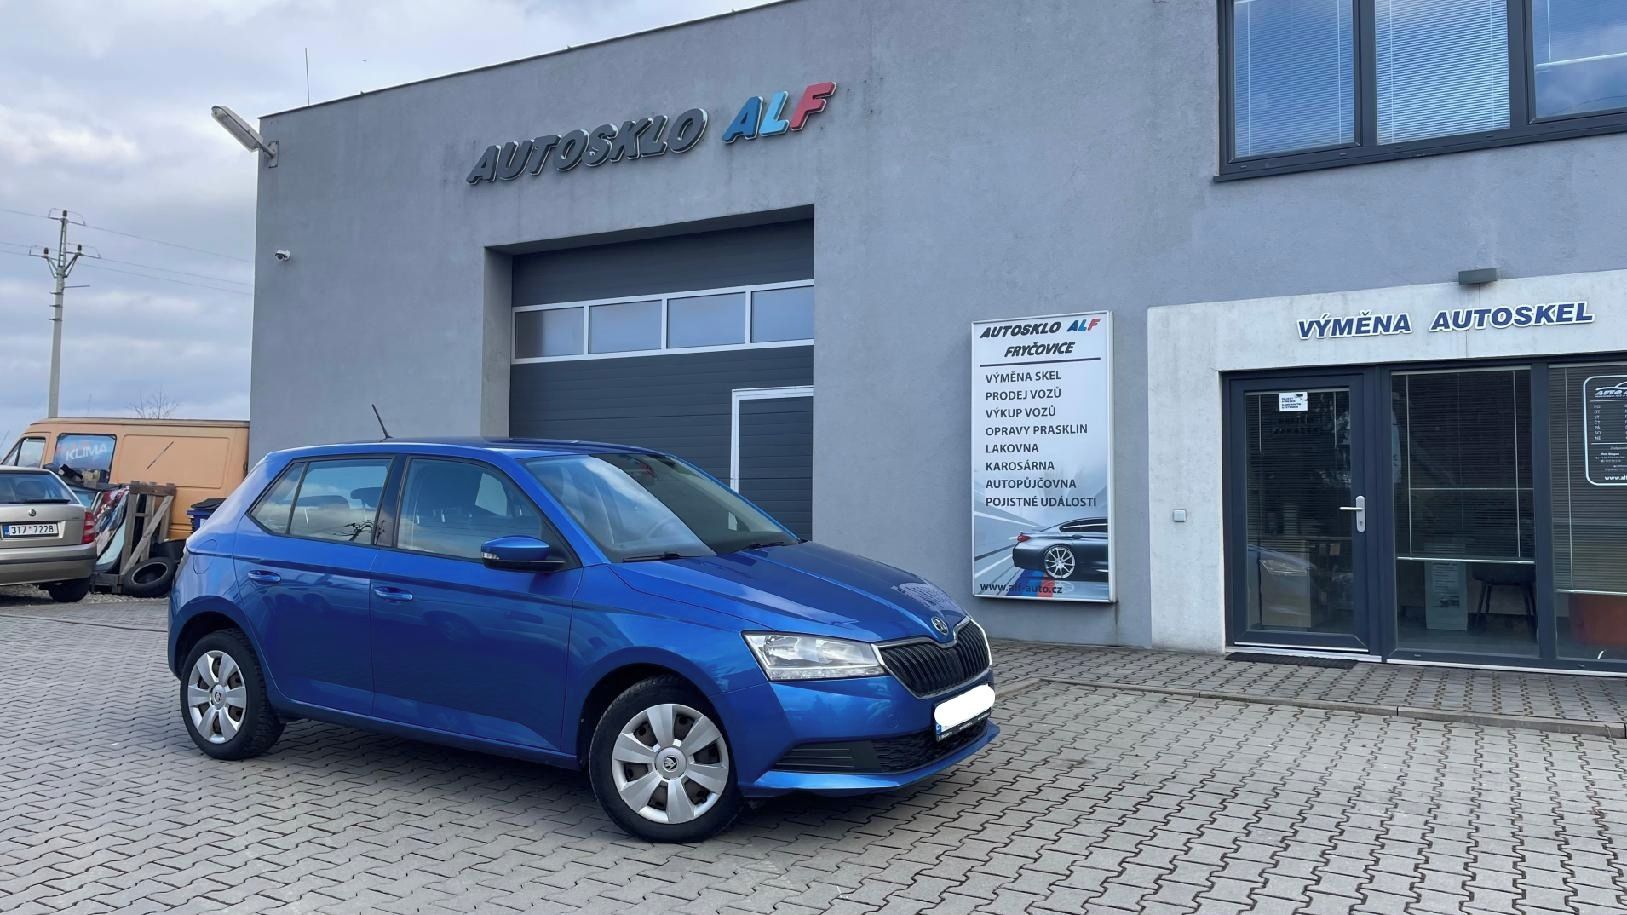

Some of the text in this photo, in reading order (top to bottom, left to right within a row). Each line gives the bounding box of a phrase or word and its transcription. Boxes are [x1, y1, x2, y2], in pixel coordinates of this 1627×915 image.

[466, 81, 837, 185] AUTOSKLO ALF
[1298, 302, 1594, 339] VÝMĚNA AUTOSKEL
[980, 319, 1101, 338] AUTOSKLO ALF
[1004, 342, 1075, 357] FRYČOVICE
[985, 371, 1062, 384] VÝMĚNA SKEL
[985, 386, 1062, 401] PRODEJ VOZŮ
[985, 405, 1056, 418] VÝKUP VOZŮ
[985, 424, 1088, 436] OPRAVY PRASKLIN
[985, 443, 1039, 454] LAKOVNA
[985, 460, 1055, 471] KAROSÁRNA
[985, 477, 1077, 489] AUTOPŮJČOVNA
[985, 496, 1097, 507] POJISTNÉ UDÁLOSTI
